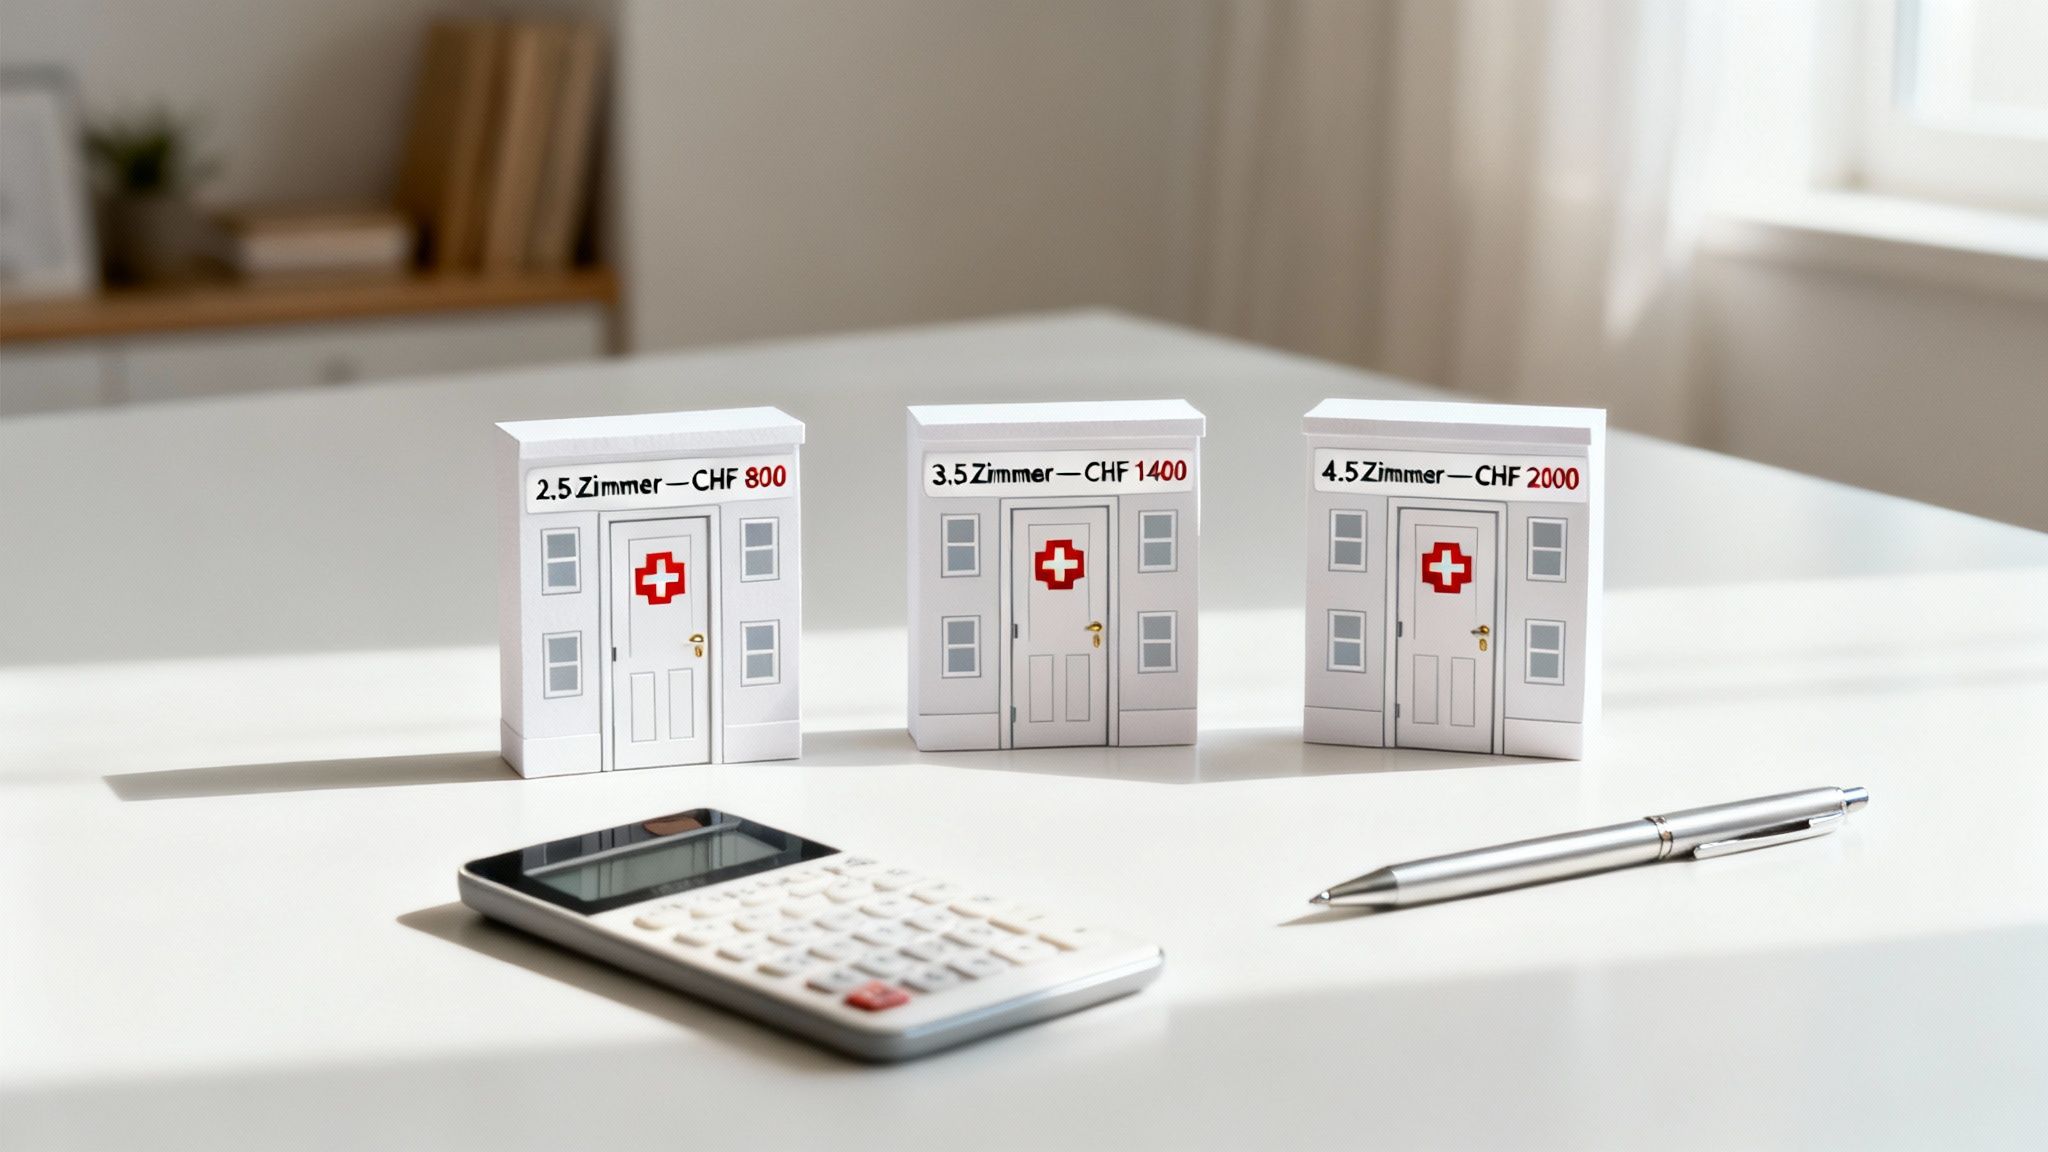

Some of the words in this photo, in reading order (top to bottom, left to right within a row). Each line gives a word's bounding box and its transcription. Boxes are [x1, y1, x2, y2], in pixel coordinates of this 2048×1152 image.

[575, 474, 663, 498] Zimmer
[691, 467, 739, 491] CHF
[744, 464, 787, 489] 800
[969, 462, 1054, 484] Zimmer
[1084, 461, 1130, 483] CHF
[1134, 459, 1188, 482] 1400
[1321, 459, 1359, 482] 4.5
[1360, 460, 1446, 484] Zimmer
[1474, 464, 1521, 487] CHF
[1526, 466, 1580, 490] 2000
